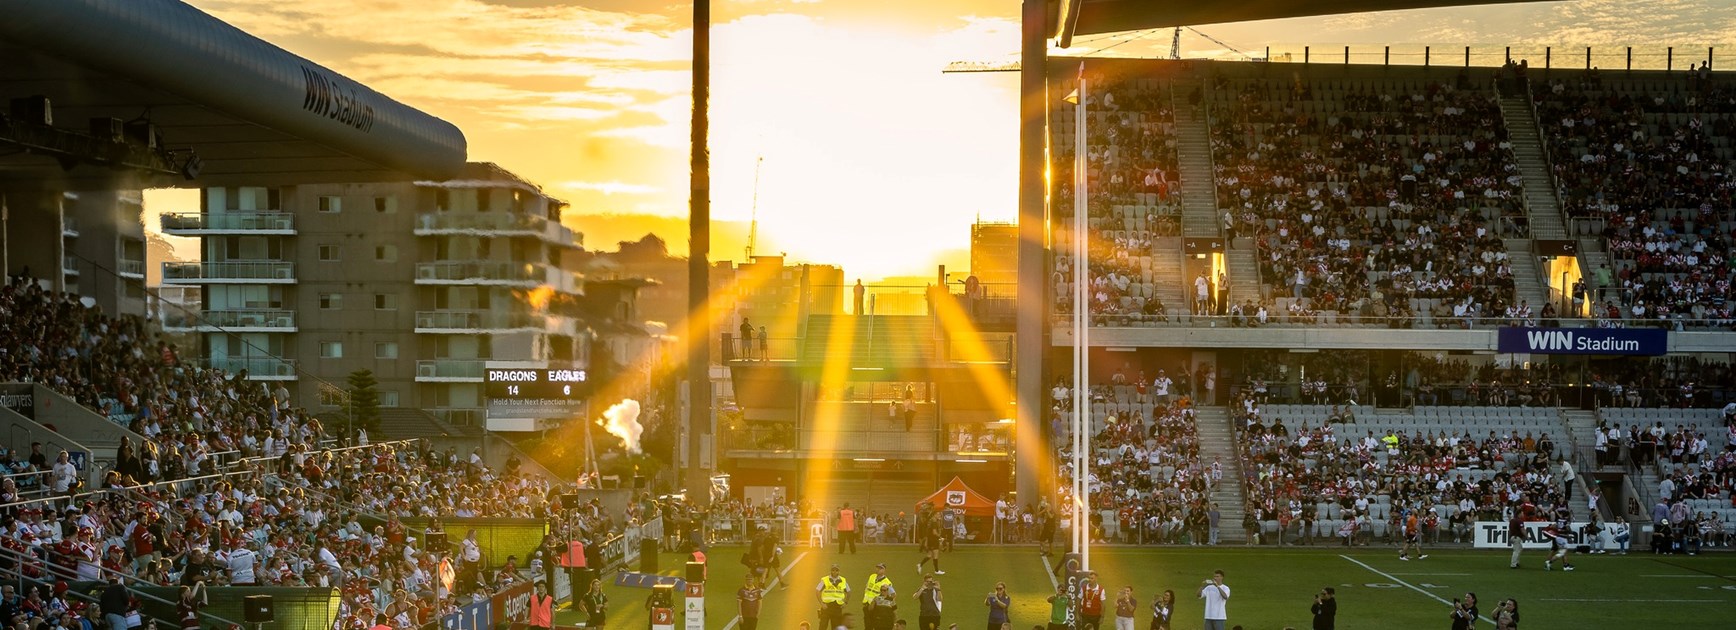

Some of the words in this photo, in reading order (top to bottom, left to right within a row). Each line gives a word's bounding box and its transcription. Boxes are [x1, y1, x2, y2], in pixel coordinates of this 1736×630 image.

[301, 65, 331, 118] WIN
[330, 81, 374, 134] Stadium
[1527, 330, 1573, 350] WIN
[1576, 336, 1639, 351] Stadium
[489, 370, 537, 381] DRAGONS
[507, 385, 519, 395] 14
[563, 385, 571, 395] 6
[493, 398, 508, 406] Hold
[509, 398, 522, 406] Your
[524, 398, 539, 406] Next
[540, 397, 566, 406] Function
